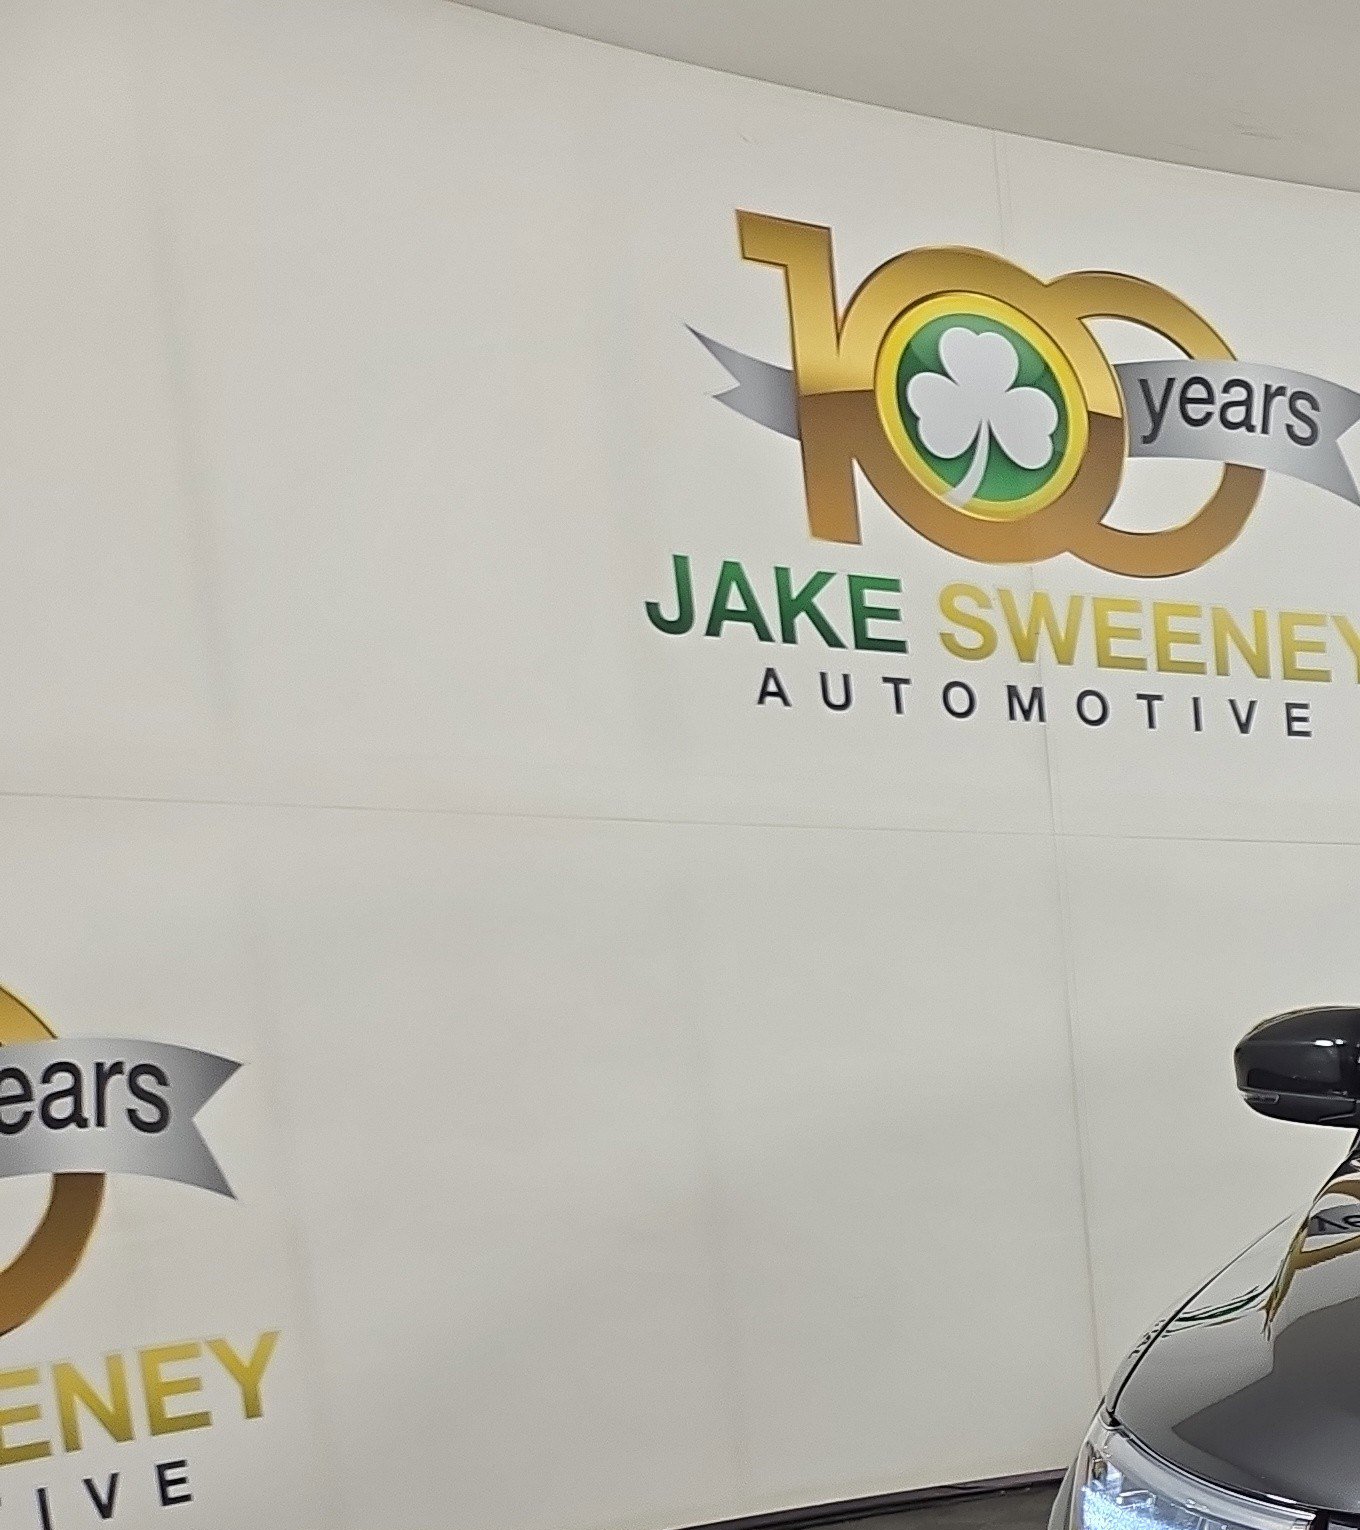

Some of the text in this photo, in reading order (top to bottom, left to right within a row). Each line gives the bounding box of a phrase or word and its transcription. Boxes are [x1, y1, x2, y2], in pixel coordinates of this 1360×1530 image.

[735, 208, 1321, 578] 100 years
[644, 554, 909, 654] JAKE
[757, 667, 1312, 738] AUTOMOTIVE
[0, 1061, 170, 1135] ears
[0, 1331, 280, 1467] ENEY
